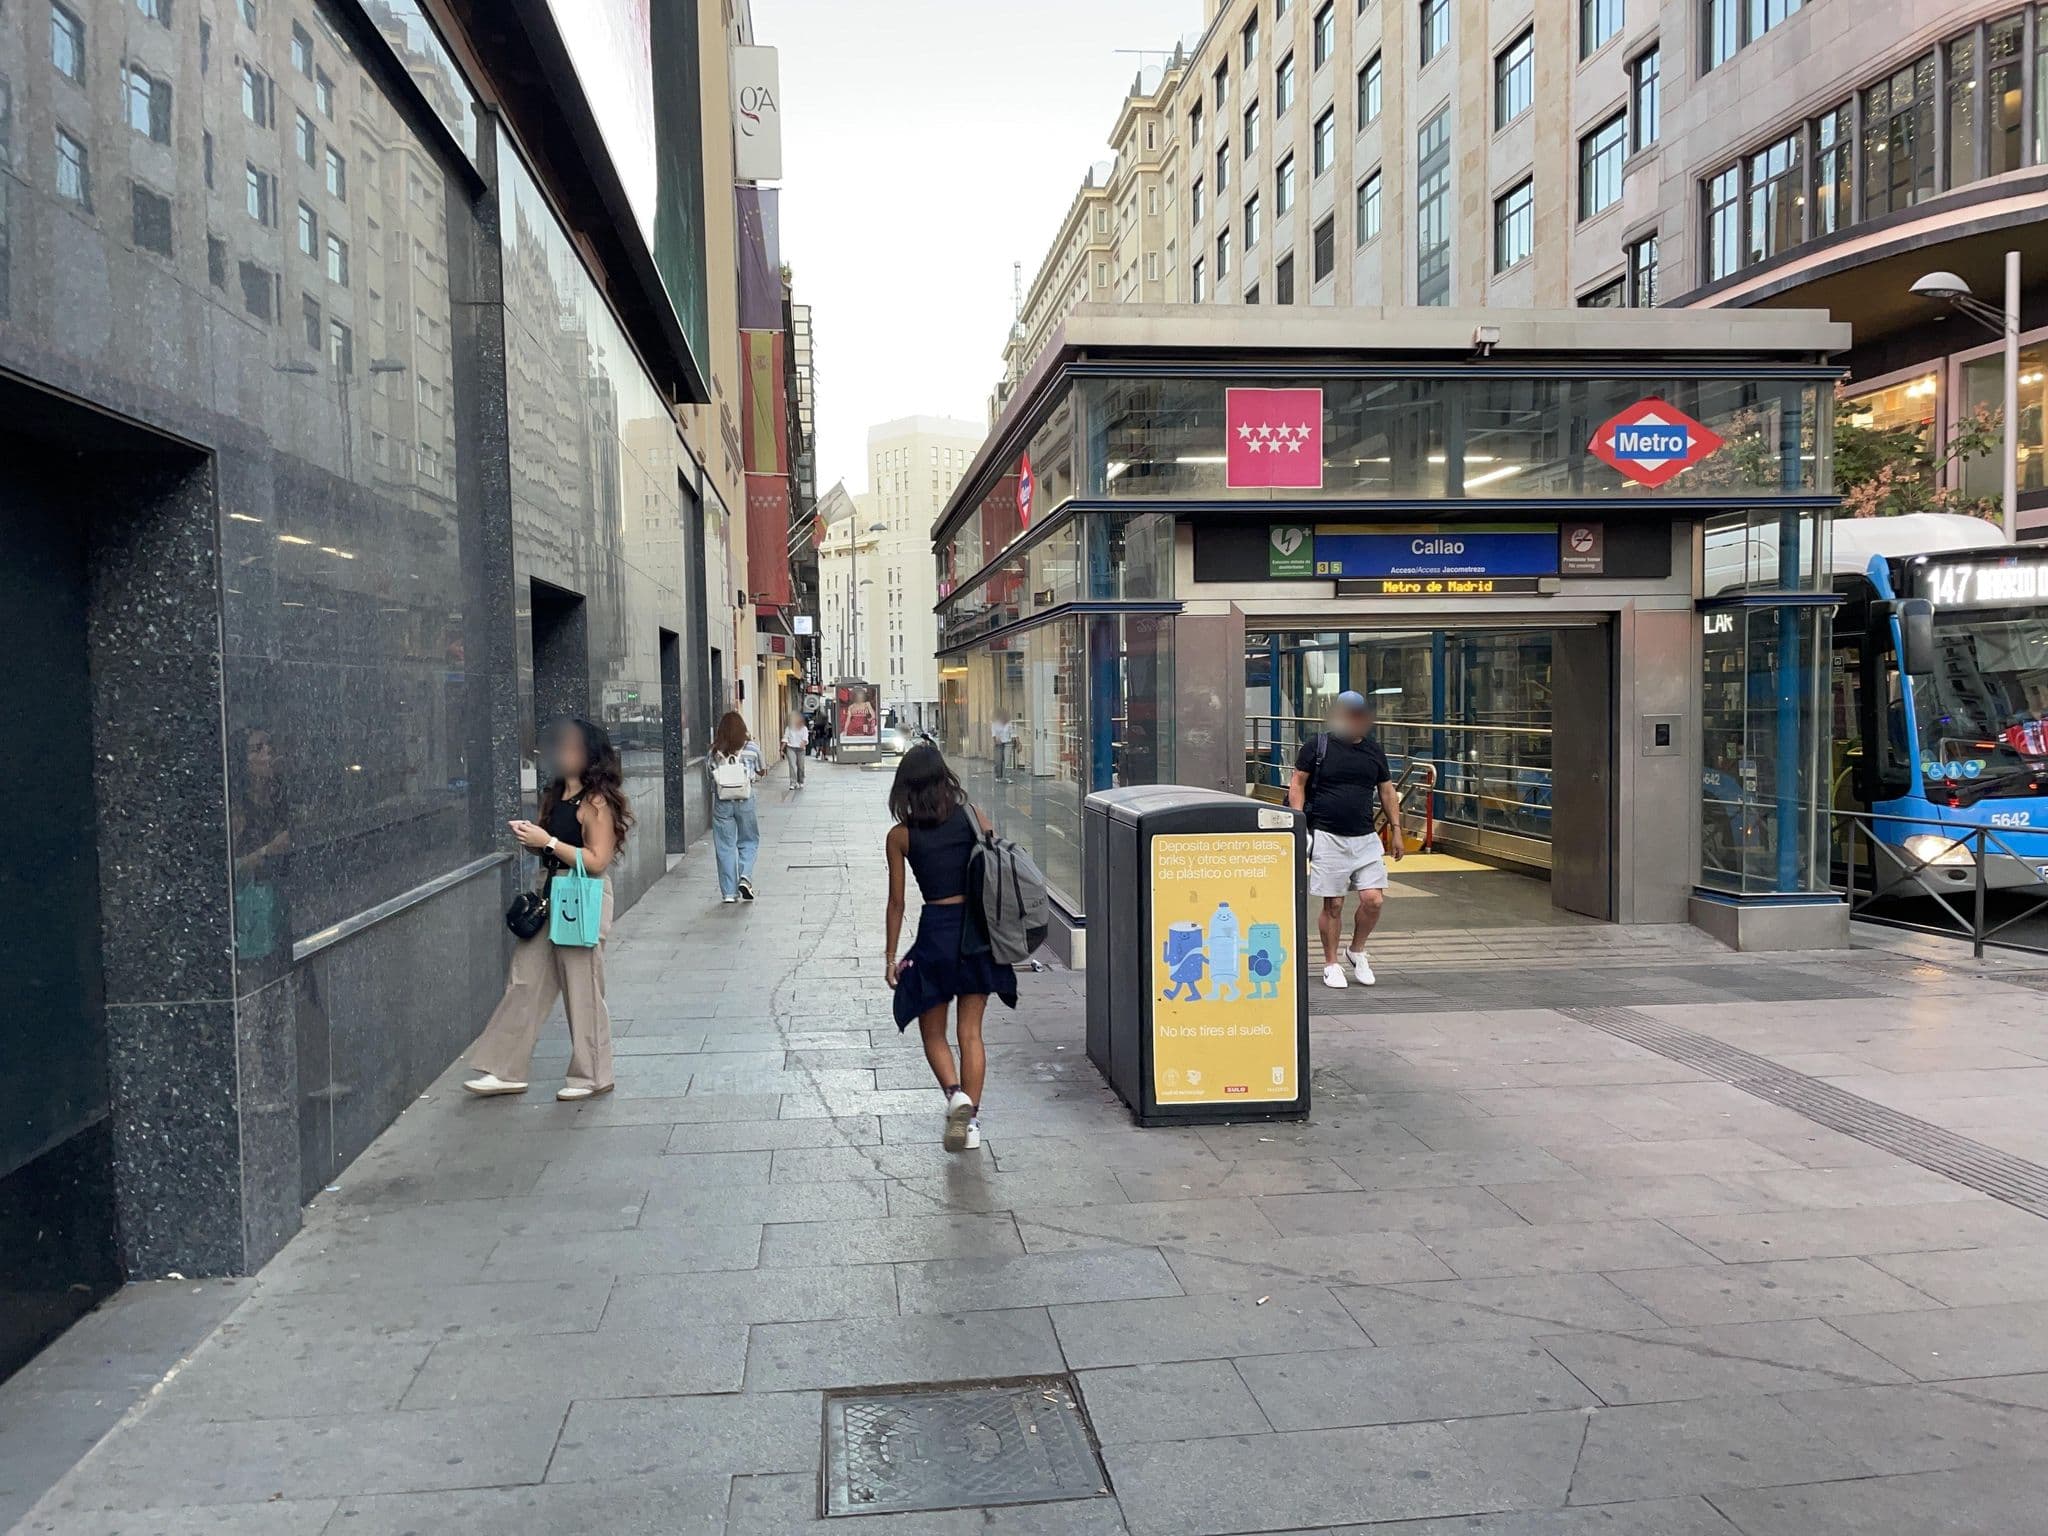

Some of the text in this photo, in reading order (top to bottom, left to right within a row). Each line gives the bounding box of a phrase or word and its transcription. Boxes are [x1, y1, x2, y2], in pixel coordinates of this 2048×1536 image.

[1619, 432, 1683, 452] Metro
[1411, 539, 1465, 555] Callao
[1383, 581, 1493, 593] Metro de Madrid
[1927, 566, 1972, 604] 147
[1991, 811, 2031, 827] 5642
[1159, 839, 1282, 853] Deposita dentro latas,
[1159, 854, 1278, 867] briks y otros envases
[1159, 868, 1174, 880] de
[1177, 866, 1222, 881] plástico
[1224, 868, 1232, 878] o
[1160, 1025, 1178, 1037] No
[1180, 1025, 1197, 1037] los
[1200, 1024, 1225, 1036] tires
[1227, 1024, 1237, 1036] al
